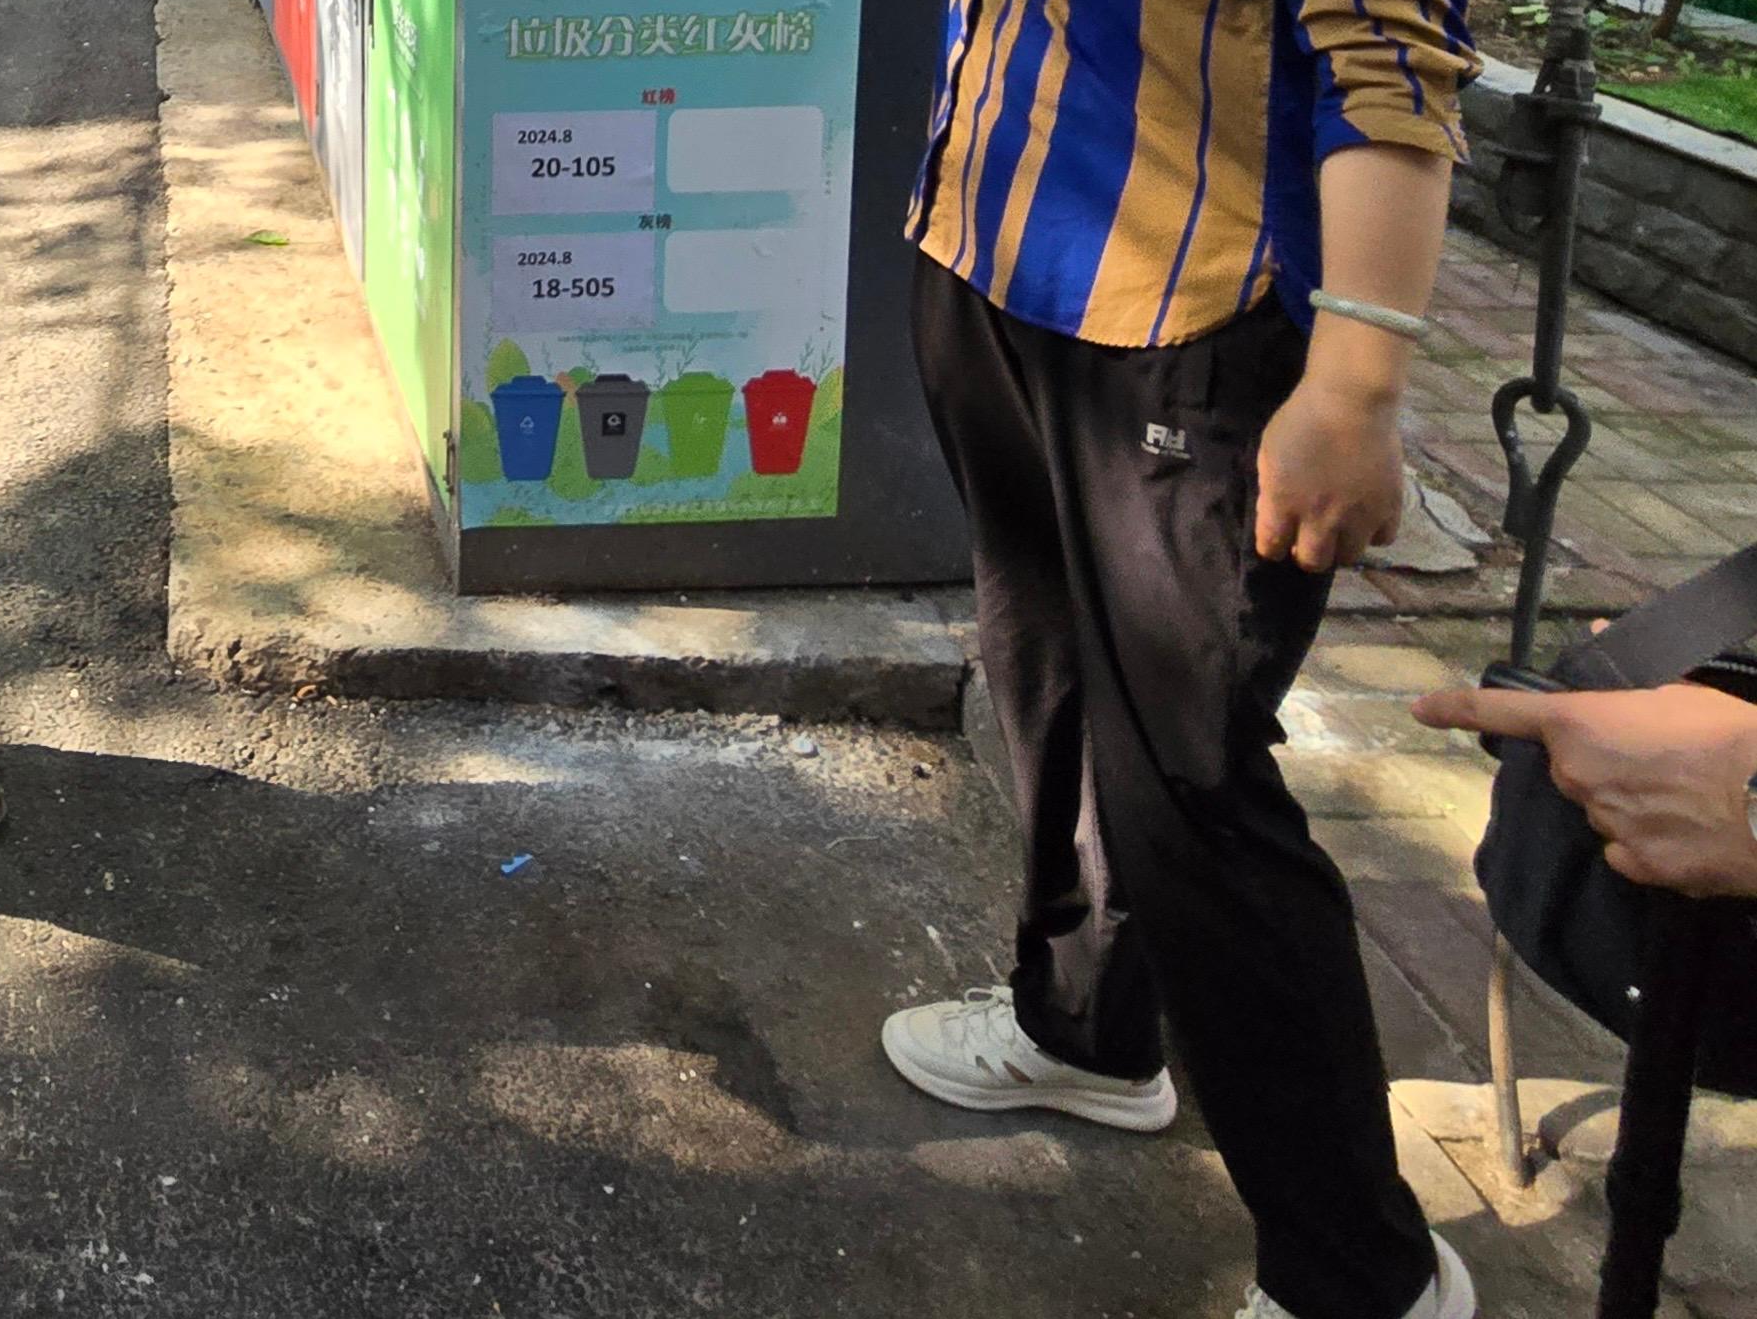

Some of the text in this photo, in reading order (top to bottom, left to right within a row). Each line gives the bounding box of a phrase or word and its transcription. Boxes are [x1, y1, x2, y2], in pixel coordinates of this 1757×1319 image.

[641, 88, 676, 105] 红榜
[517, 129, 573, 145] 2024.8
[531, 156, 616, 178] 20-105
[638, 213, 672, 230] 灰榜
[517, 251, 573, 266] 2024.8
[532, 277, 615, 299] 18-505
